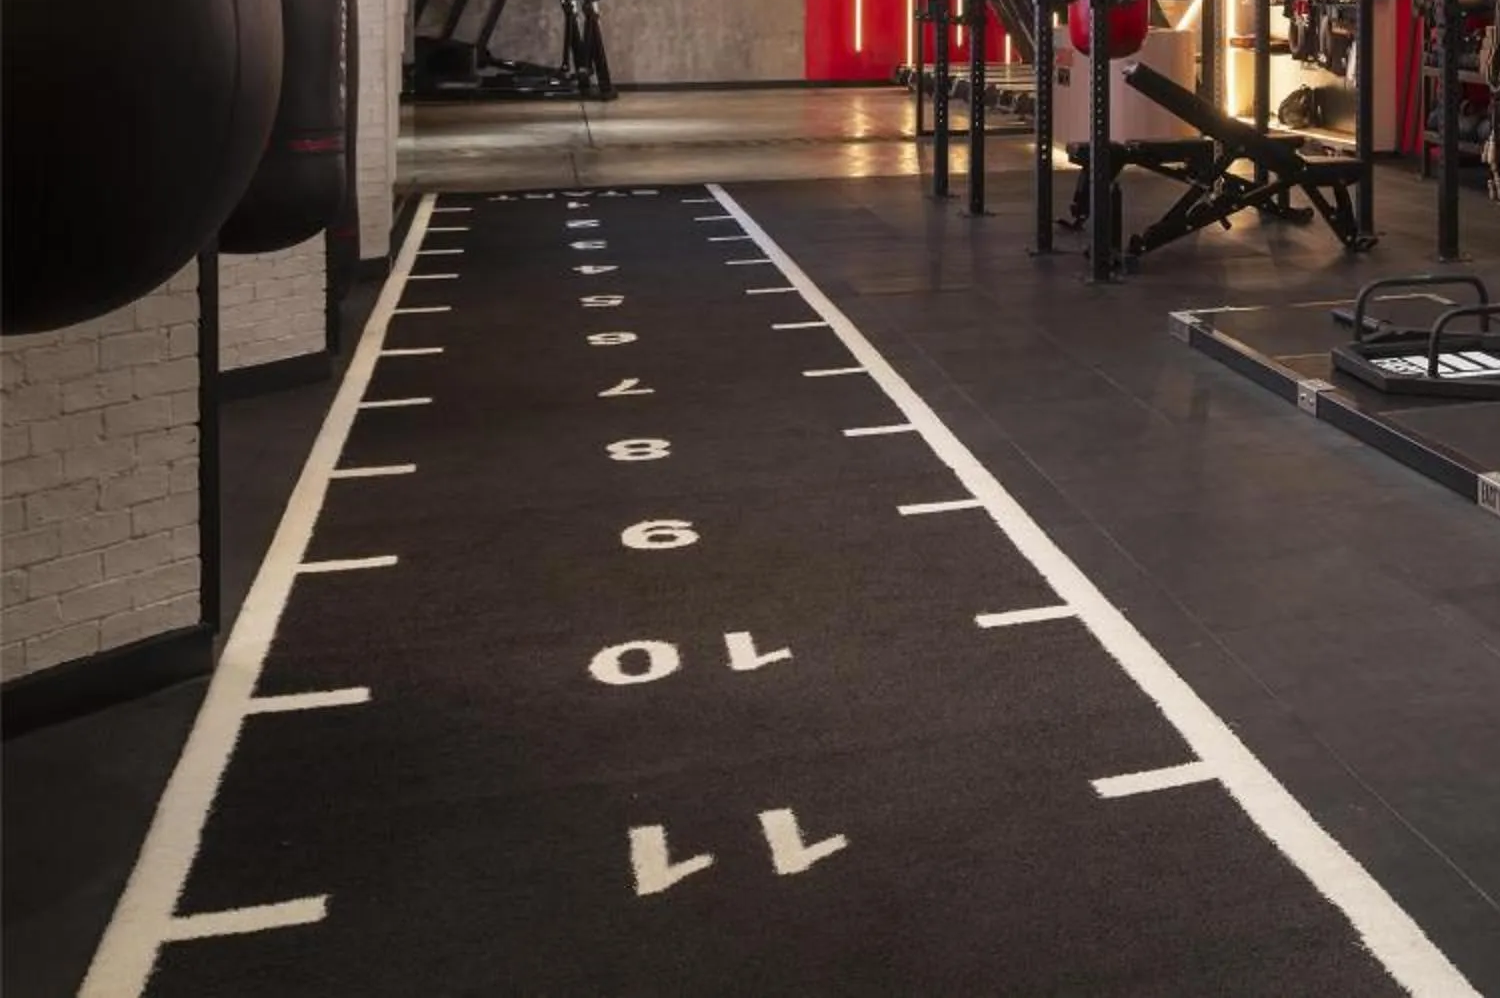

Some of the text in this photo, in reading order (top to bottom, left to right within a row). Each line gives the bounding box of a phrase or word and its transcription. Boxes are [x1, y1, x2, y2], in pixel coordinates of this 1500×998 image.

[488, 190, 659, 201] START
[566, 219, 600, 228] 2
[569, 241, 607, 250] 3
[572, 265, 619, 275] 4
[579, 295, 625, 307] 5
[586, 331, 639, 346] 6
[597, 377, 656, 397] 7
[605, 438, 672, 462] 8
[620, 518, 702, 551] 9
[587, 630, 794, 686] 10
[628, 807, 849, 897] 11
